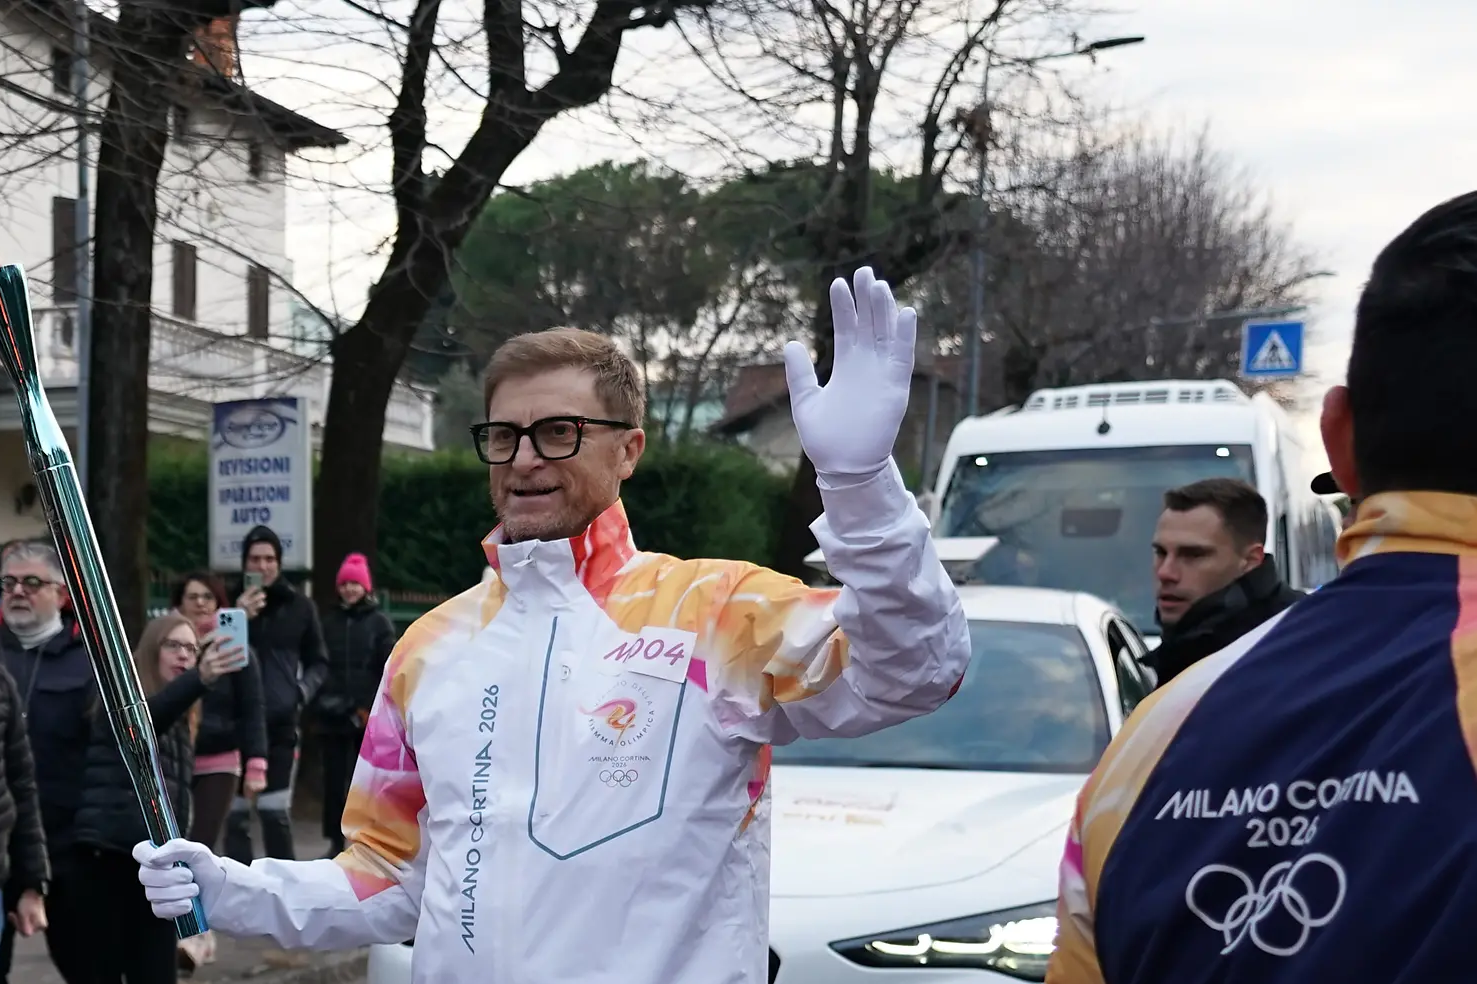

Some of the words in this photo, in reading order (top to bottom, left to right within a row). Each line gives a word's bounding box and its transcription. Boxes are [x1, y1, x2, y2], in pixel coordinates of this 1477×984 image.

[231, 507, 271, 525] AUTO
[478, 684, 500, 733] 2026
[469, 740, 493, 843] CORTINA
[1154, 782, 1280, 820] MILANO
[1246, 815, 1321, 848] 2026
[461, 848, 482, 955] MILANO
